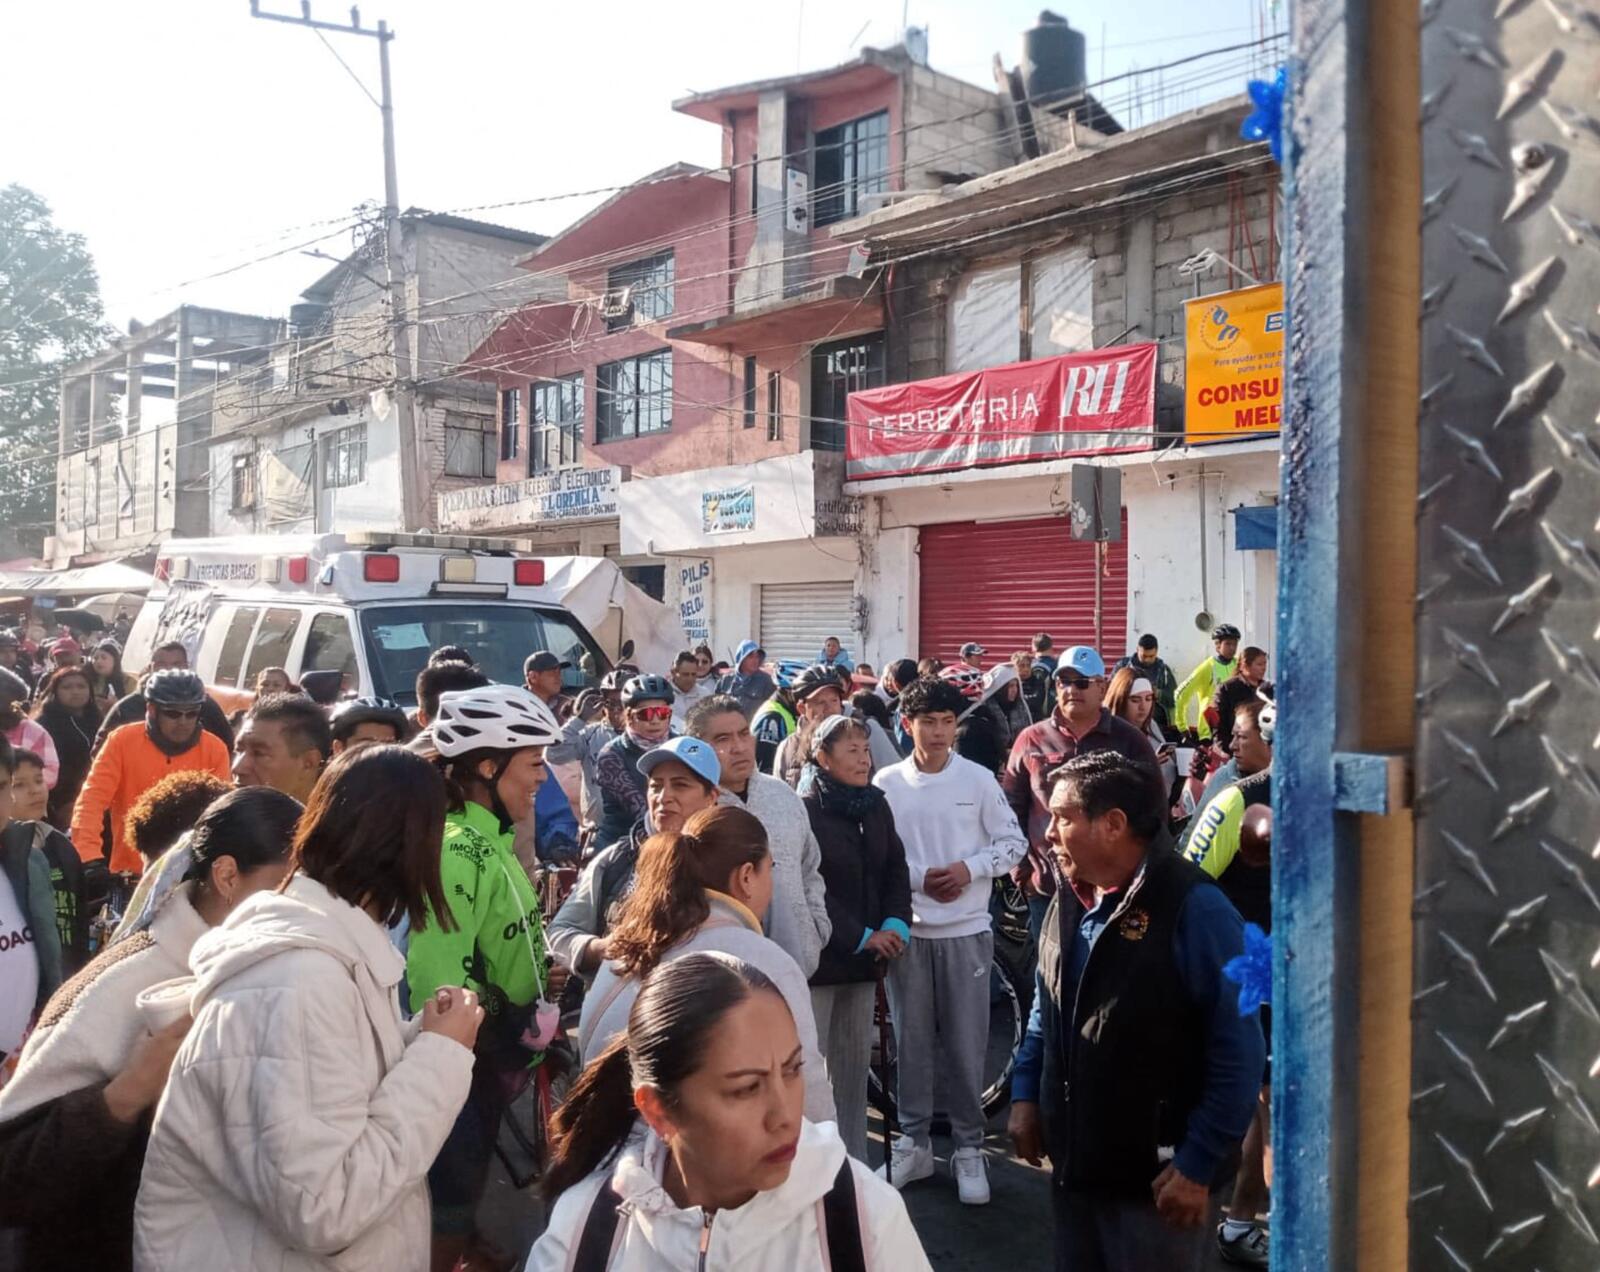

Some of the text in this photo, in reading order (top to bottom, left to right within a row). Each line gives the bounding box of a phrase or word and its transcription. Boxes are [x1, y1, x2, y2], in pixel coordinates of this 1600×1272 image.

[867, 361, 1133, 440] FERRETERÍA RH
[1198, 377, 1279, 407] CONSU
[1235, 404, 1281, 428] MED
[566, 469, 612, 491] ELECTRONICOS
